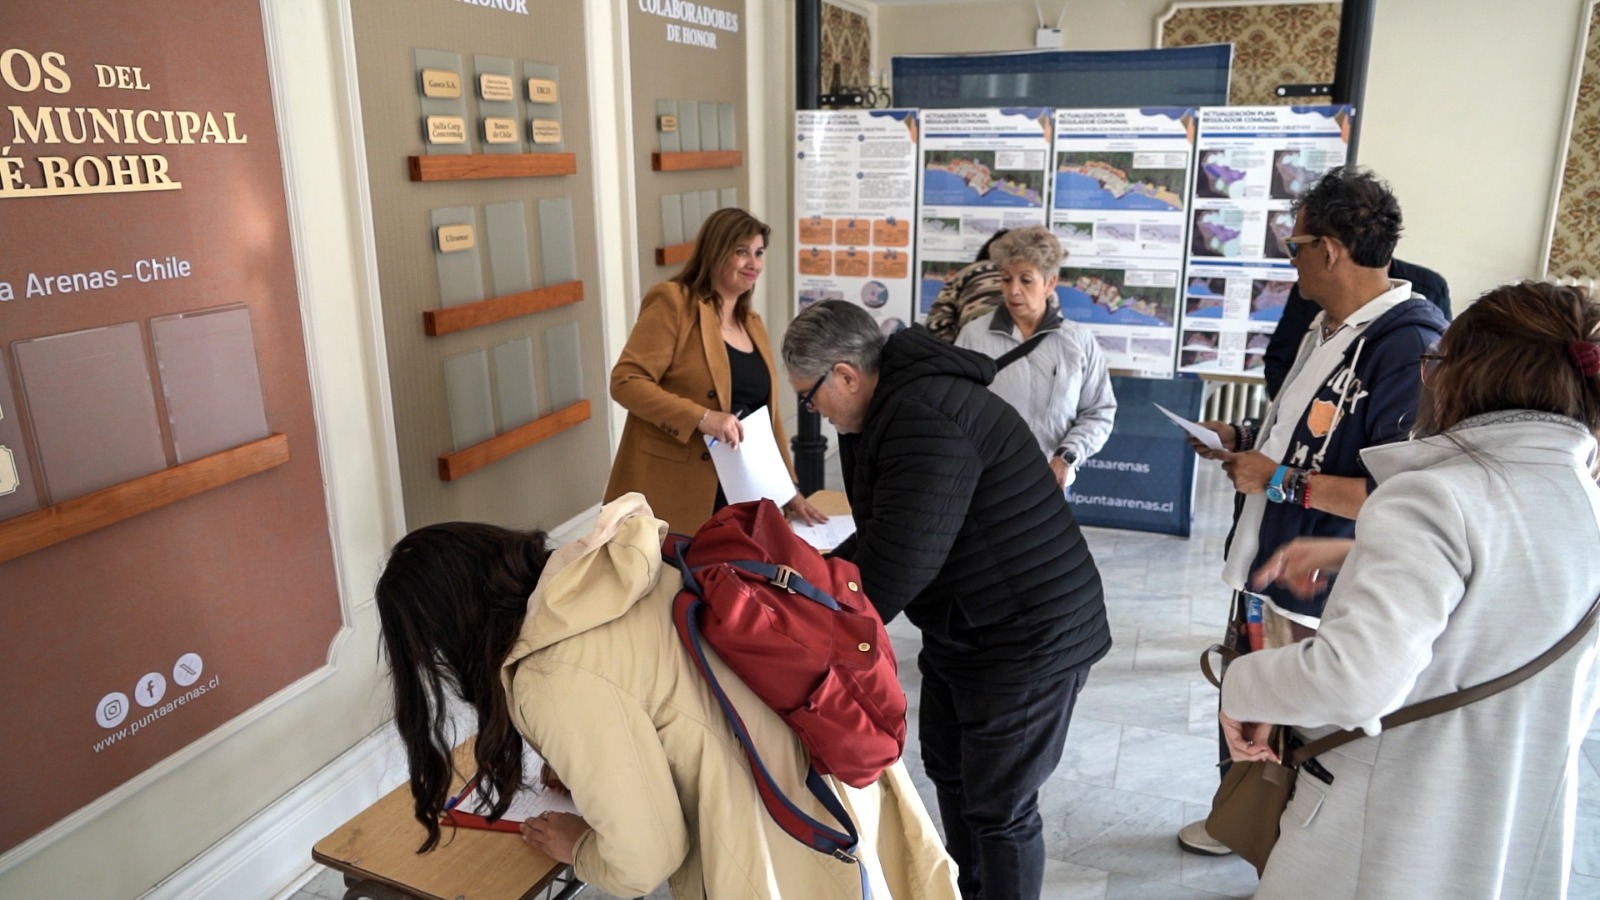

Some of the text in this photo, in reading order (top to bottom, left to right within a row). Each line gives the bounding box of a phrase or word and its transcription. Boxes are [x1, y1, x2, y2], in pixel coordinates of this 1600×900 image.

[638, 0, 739, 33] COLABORADORES
[666, 24, 717, 49] DE HONOR
[0, 48, 151, 94] OS DEL
[428, 79, 446, 88] Gasco
[7, 105, 248, 145] MUNICIPAL
[500, 131, 512, 139] Chile
[38, 153, 174, 188] BOHR
[92, 675, 220, 753] www.puntaarenas.cl
